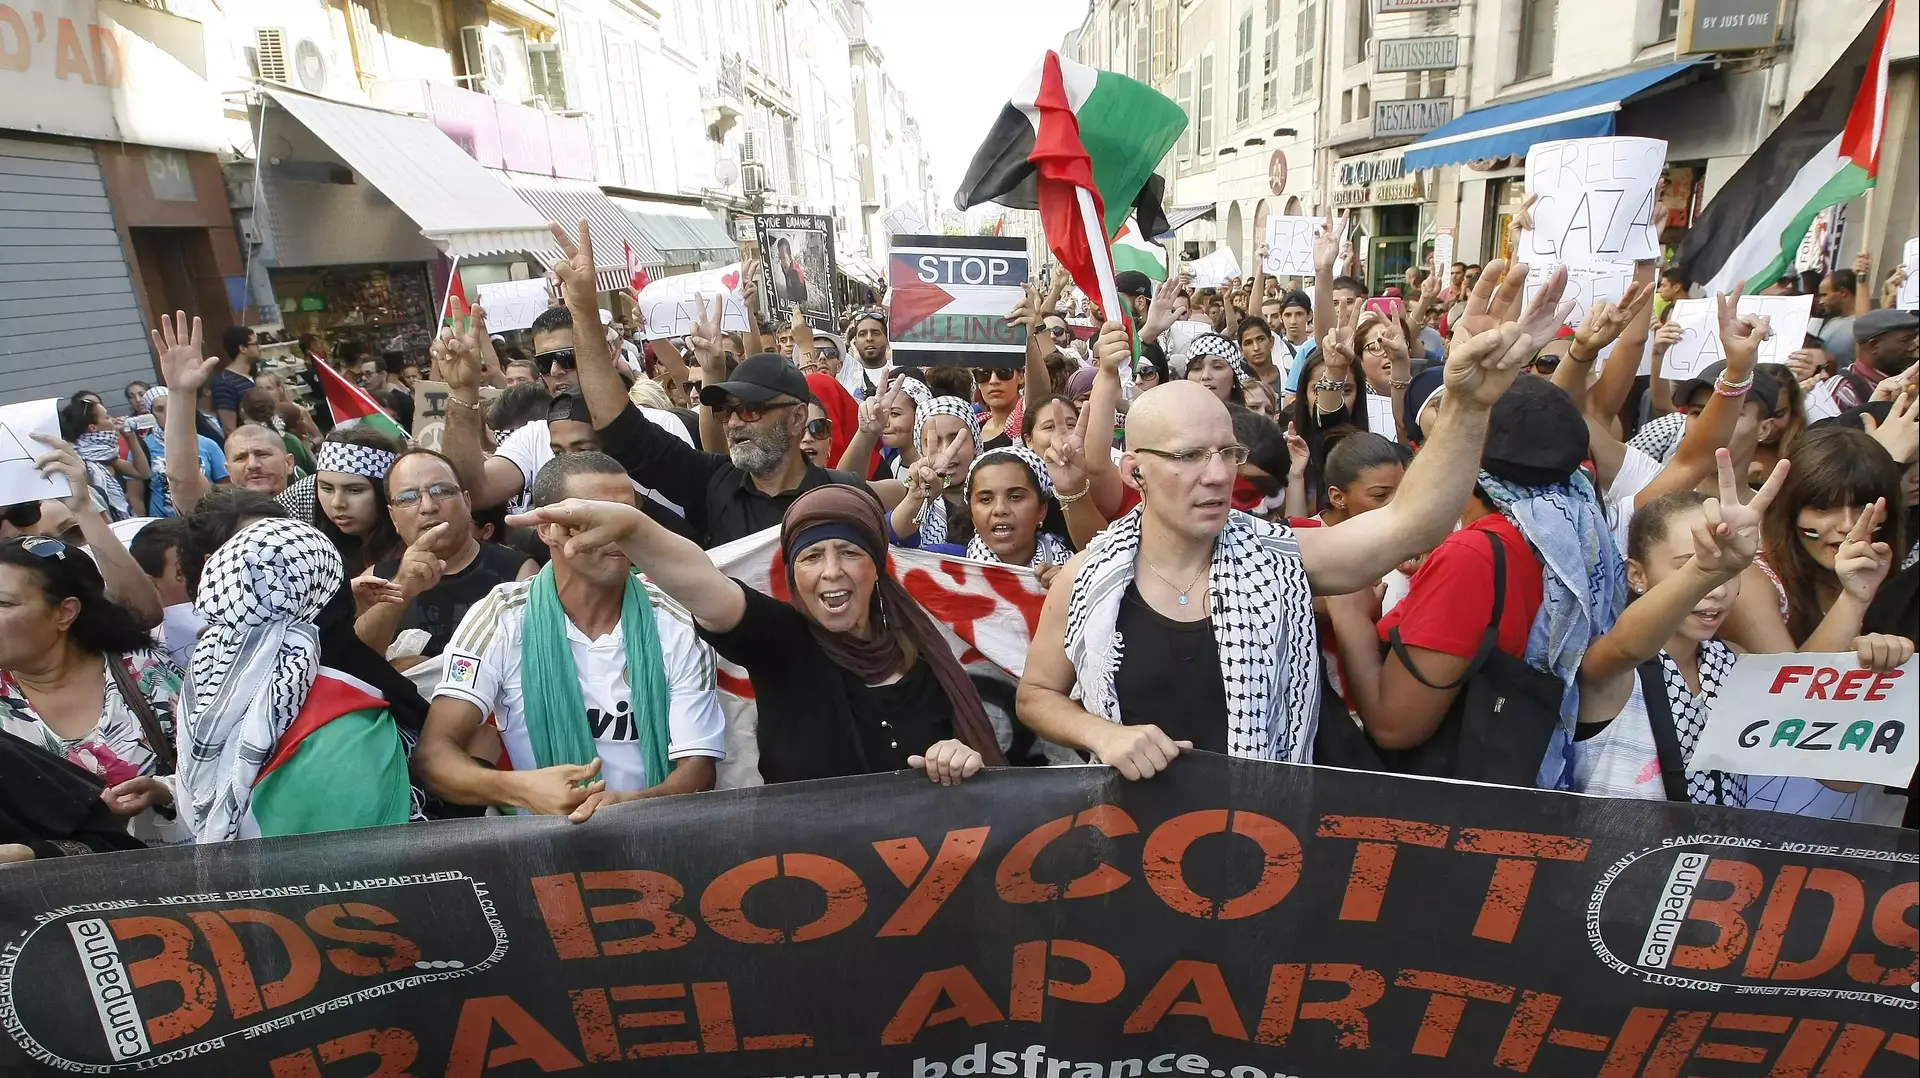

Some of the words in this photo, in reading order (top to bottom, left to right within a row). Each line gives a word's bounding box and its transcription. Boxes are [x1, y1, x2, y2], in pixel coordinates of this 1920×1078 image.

[1702, 16, 1718, 29] BY
[1720, 14, 1745, 28] JUST
[1748, 12, 1769, 26] ONE
[1383, 40, 1454, 69] PATISSERIE
[1378, 101, 1449, 131] RESTAURANT
[150, 154, 182, 182] 54
[1532, 139, 1637, 192] FREE
[1376, 183, 1417, 201] PATISSERIE
[1530, 187, 1653, 259] GAZA
[917, 255, 1009, 285] STOP
[1267, 247, 1316, 273] GAZ
[479, 281, 531, 302] FREE
[644, 272, 716, 297] FREE
[487, 299, 546, 329] GAZA
[1669, 328, 1778, 373] GAA
[1768, 665, 1905, 701] FREE
[1738, 718, 1906, 755] GAZAA
[1662, 834, 1763, 849] SANCTIONS
[1780, 841, 1840, 856] NOTRE
[225, 884, 311, 900] REPONSE
[317, 883, 332, 894] A
[530, 803, 1593, 961] BOYCOTT
[34, 899, 140, 925] SANCTIONS
[158, 892, 221, 906] NOTRE
[1586, 851, 1637, 976] DESINVESTISSEMENT
[1643, 855, 1702, 968] campagne
[77, 920, 144, 1058] campagne
[1642, 972, 1722, 993] BOYCOTT
[1836, 989, 1919, 1011] CUPATION
[135, 1038, 226, 1073] BOYCOTT
[912, 1042, 1300, 1078] bdsfrance.o
